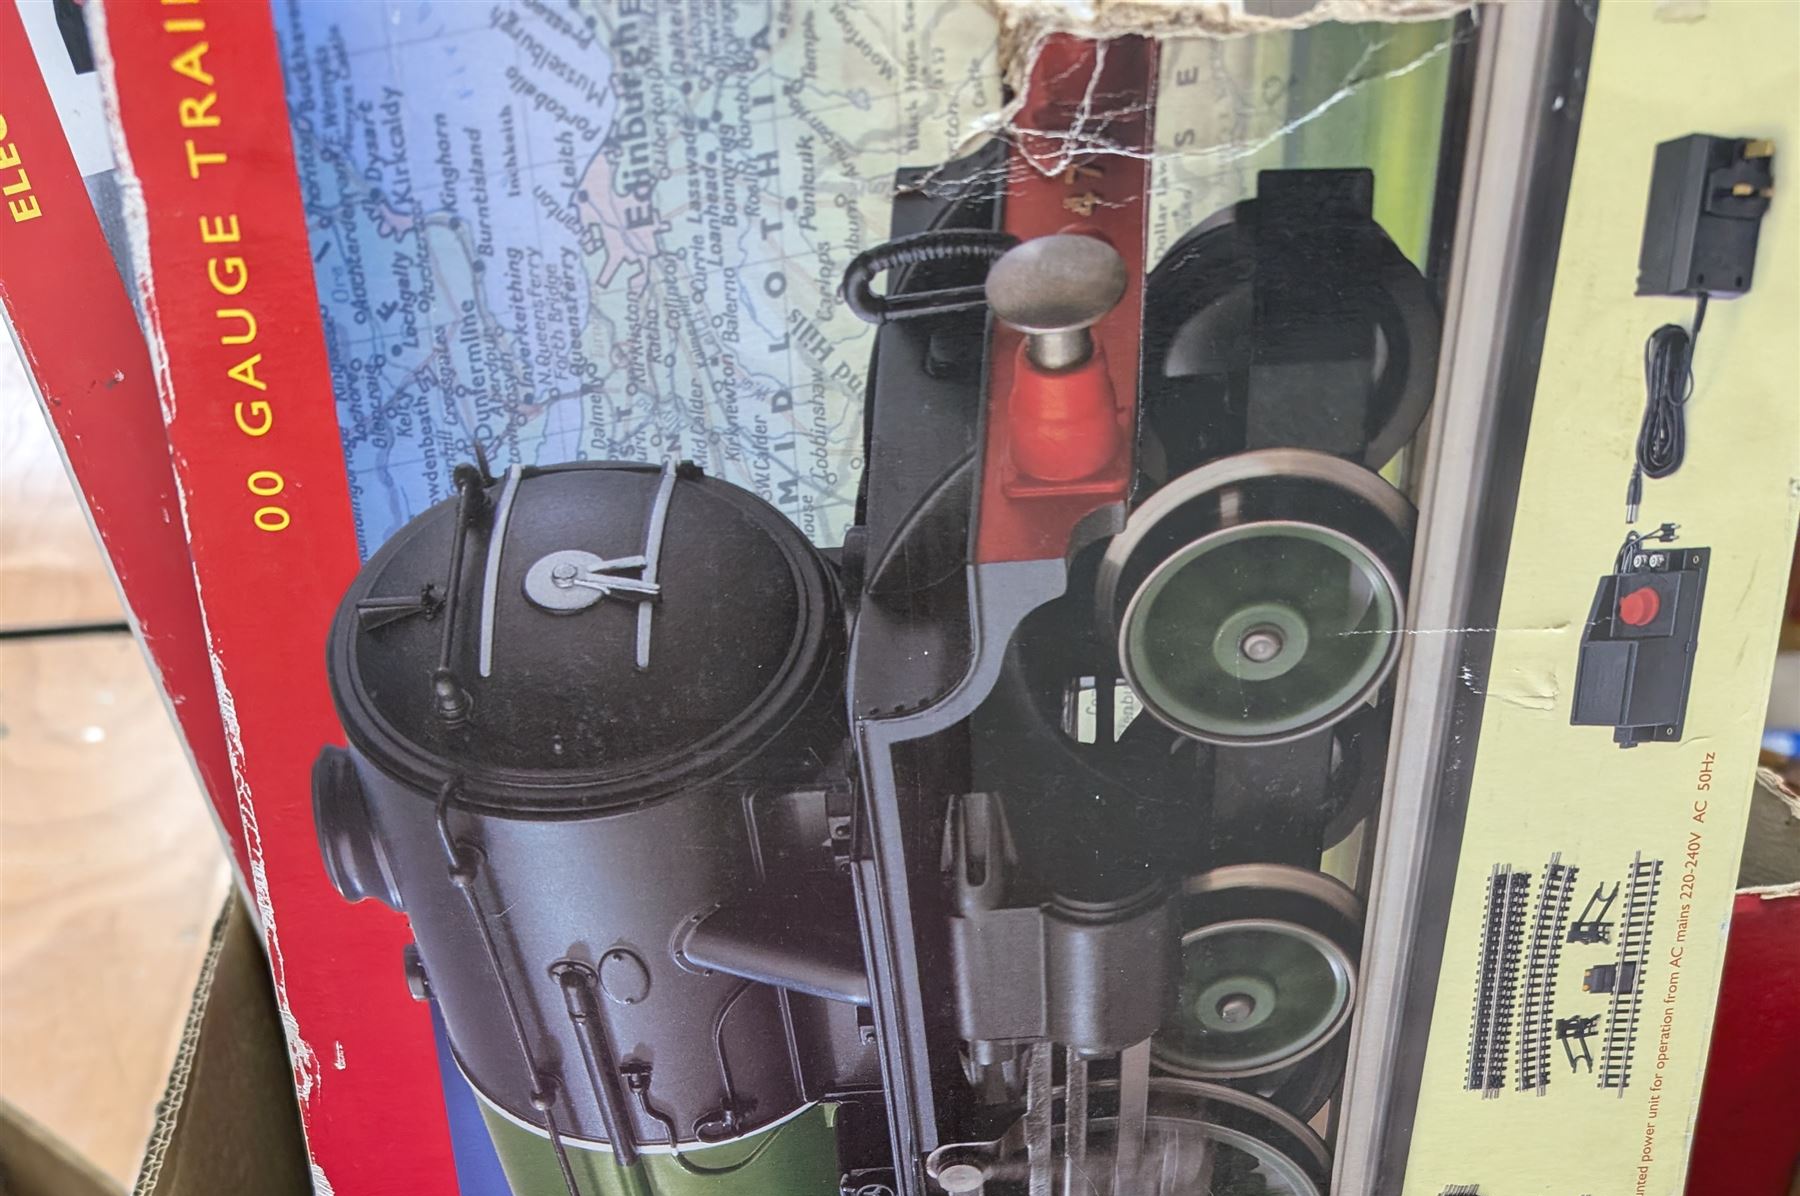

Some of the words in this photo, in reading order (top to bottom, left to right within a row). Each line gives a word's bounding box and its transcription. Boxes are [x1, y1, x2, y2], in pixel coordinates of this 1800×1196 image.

[162, 0, 228, 179] TRAI
[608, 23, 660, 229] Edinburgh
[0, 114, 42, 223] ELE
[358, 101, 383, 181] Dysart
[380, 86, 415, 204] Kirkcaldy
[434, 113, 457, 213] Kinghorn
[463, 128, 494, 256] Burntisland
[701, 166, 723, 266] Loanhead
[199, 214, 272, 437] GAUGE
[506, 247, 534, 387] Inverkeithing
[526, 246, 552, 385] N.Queensferry
[544, 263, 564, 323] Bridge
[560, 246, 589, 376] Queensferry
[722, 266, 739, 342] Balerno
[461, 300, 492, 440] Dunfermline
[550, 330, 571, 380] Forth
[785, 308, 834, 362] Hills
[720, 353, 739, 461] Kirknewton
[1697, 751, 1715, 791] 50Hz
[1692, 800, 1707, 823] AC
[1680, 832, 1701, 899] 220-240V
[1669, 946, 1683, 968] AC
[1676, 903, 1690, 942] mains
[1663, 971, 1679, 1004] from
[1656, 1007, 1674, 1069] operation
[1647, 1094, 1660, 1118] unit
[1648, 1072, 1663, 1091] for
[1641, 1122, 1655, 1162] power
